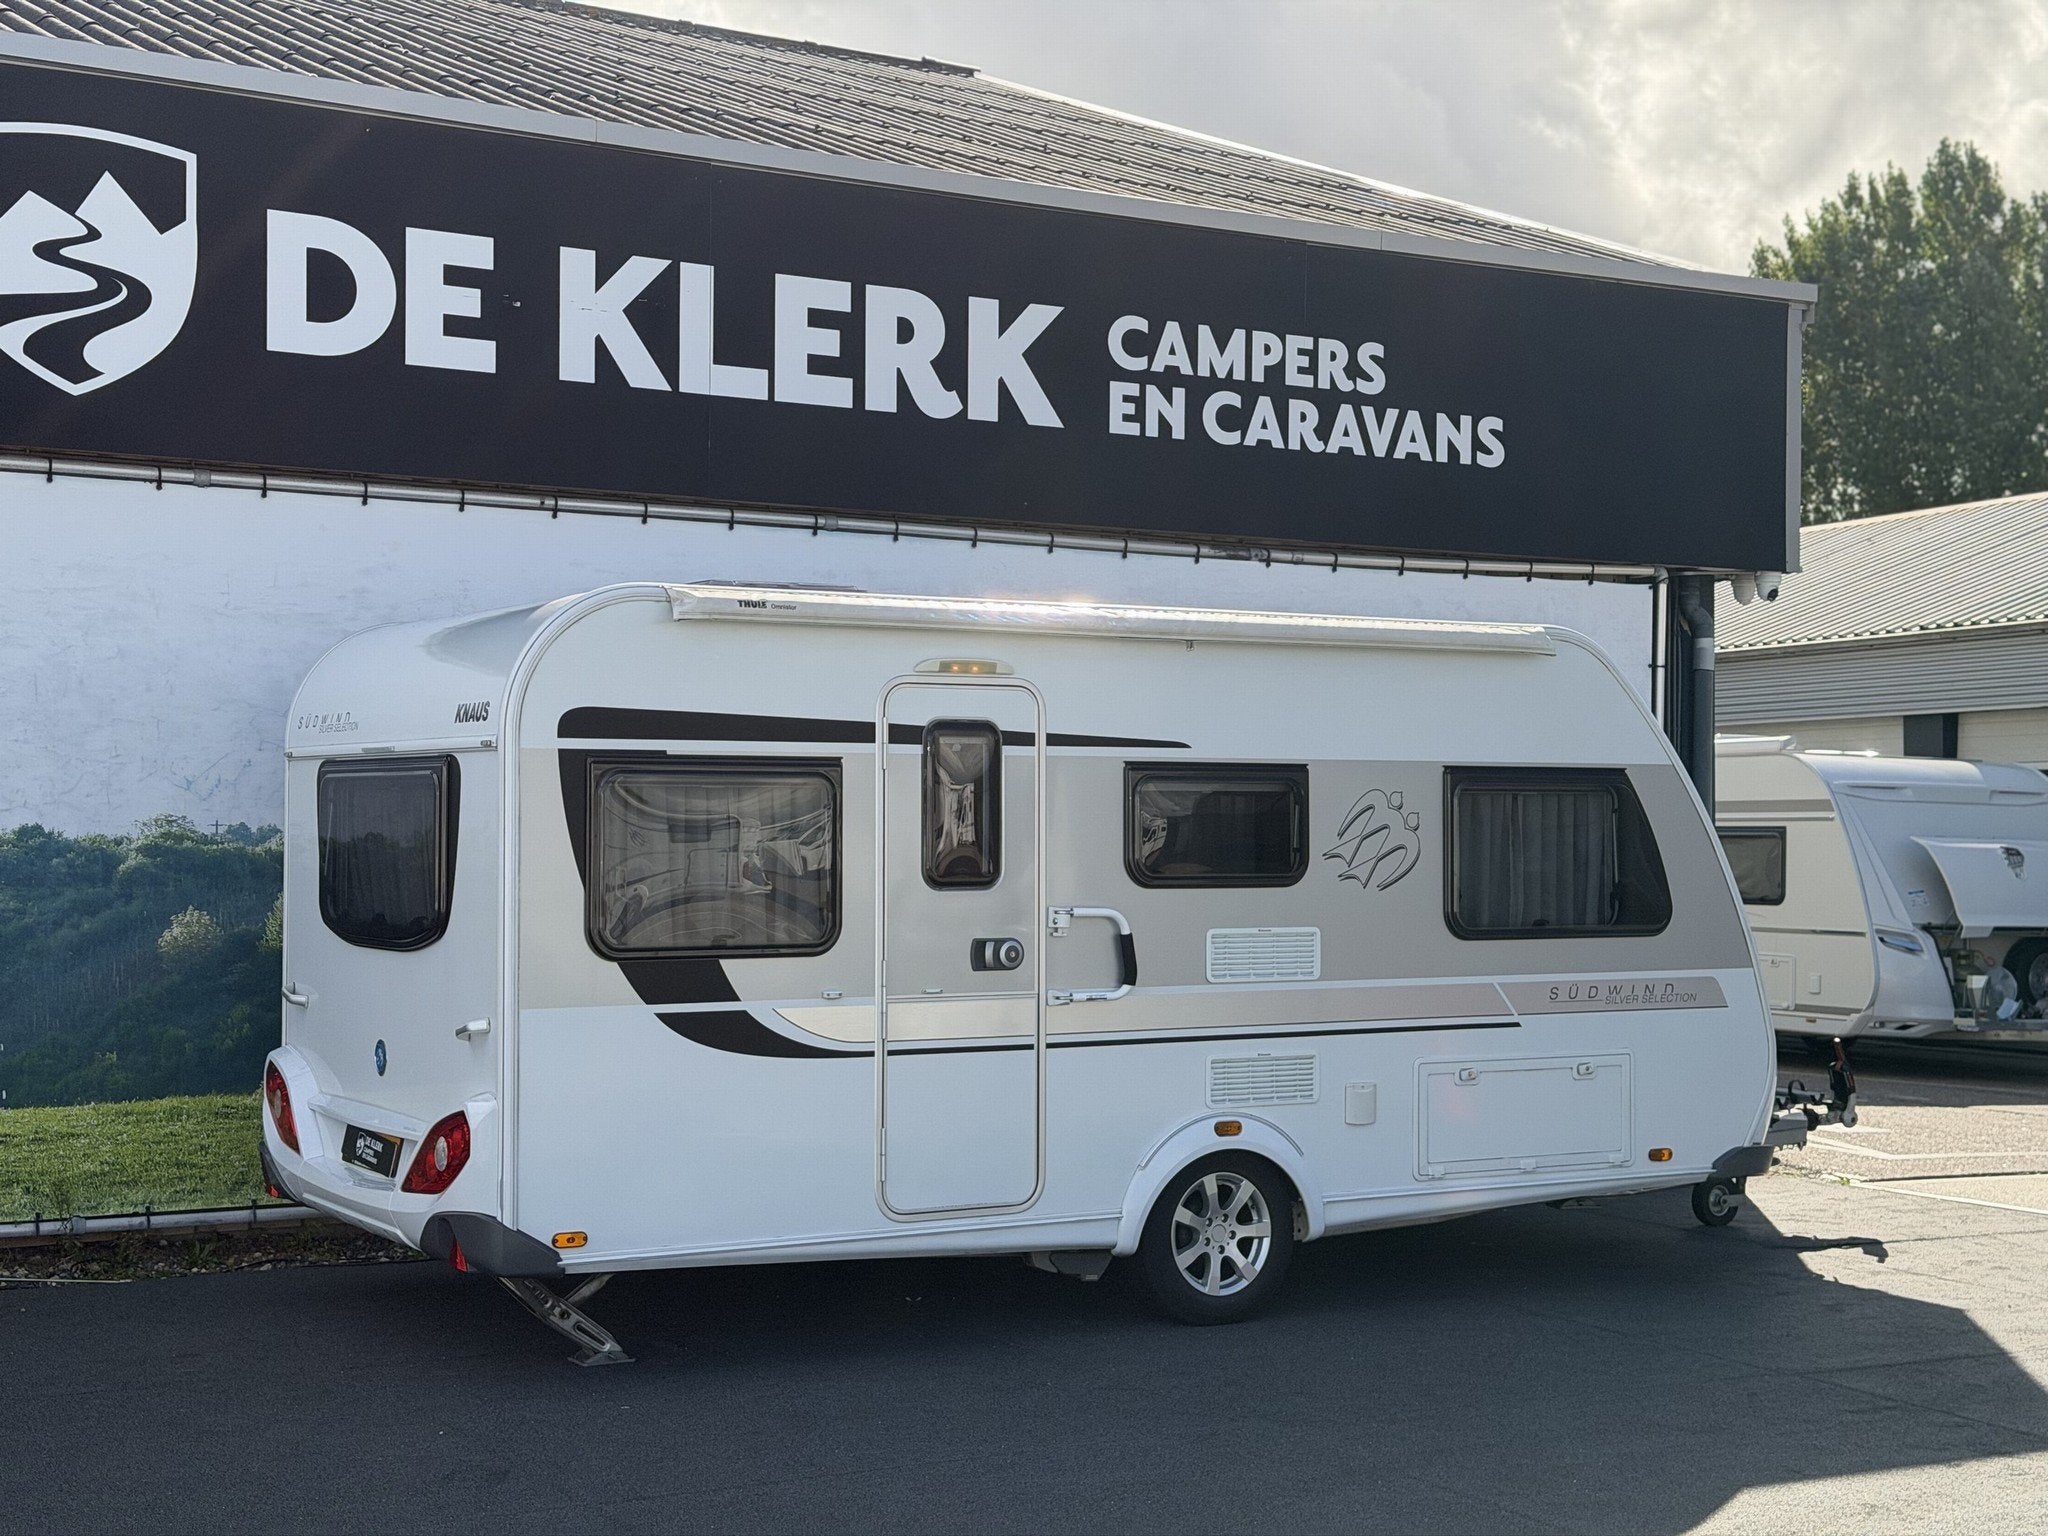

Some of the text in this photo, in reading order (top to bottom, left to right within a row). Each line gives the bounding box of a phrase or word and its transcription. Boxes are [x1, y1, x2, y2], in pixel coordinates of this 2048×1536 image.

[266, 208, 1065, 429] DE KLERK
[1107, 314, 1386, 395] CAMPERS
[1108, 380, 1505, 468] EN CARAVANS
[737, 599, 768, 609] THULE
[454, 700, 491, 724] KNAUS
[1549, 983, 1675, 1001] SÜDWIND
[1604, 992, 1698, 1005] SILVER SELECTION
